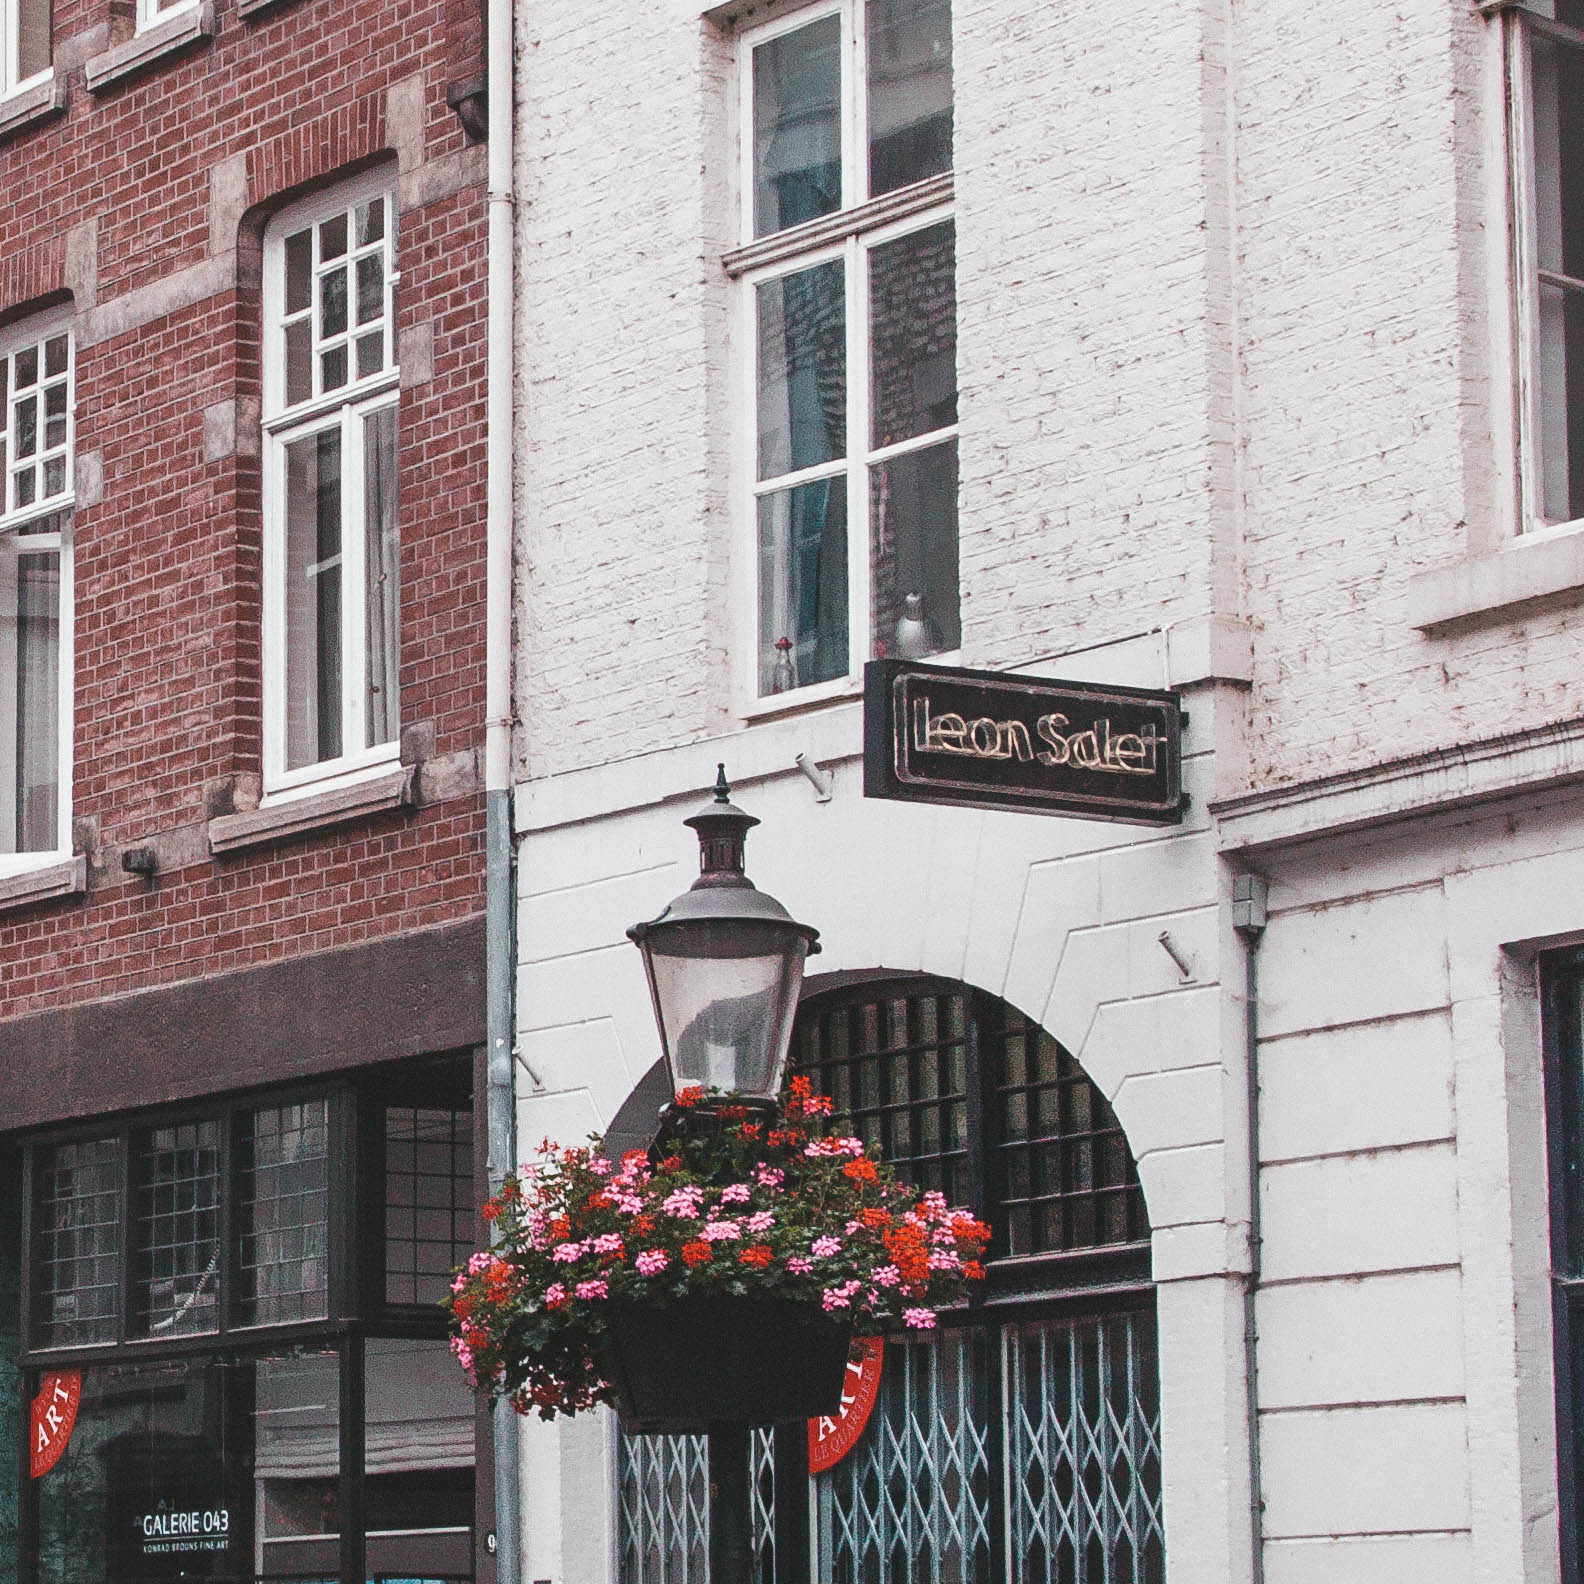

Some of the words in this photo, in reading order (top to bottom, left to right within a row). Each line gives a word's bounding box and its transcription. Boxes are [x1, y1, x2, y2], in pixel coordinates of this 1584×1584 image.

[1036, 712, 1168, 774] Salet
[37, 1377, 69, 1453] ART
[143, 1511, 200, 1535] GALERIE
[203, 1509, 229, 1532] 043
[216, 1539, 229, 1549] ART
